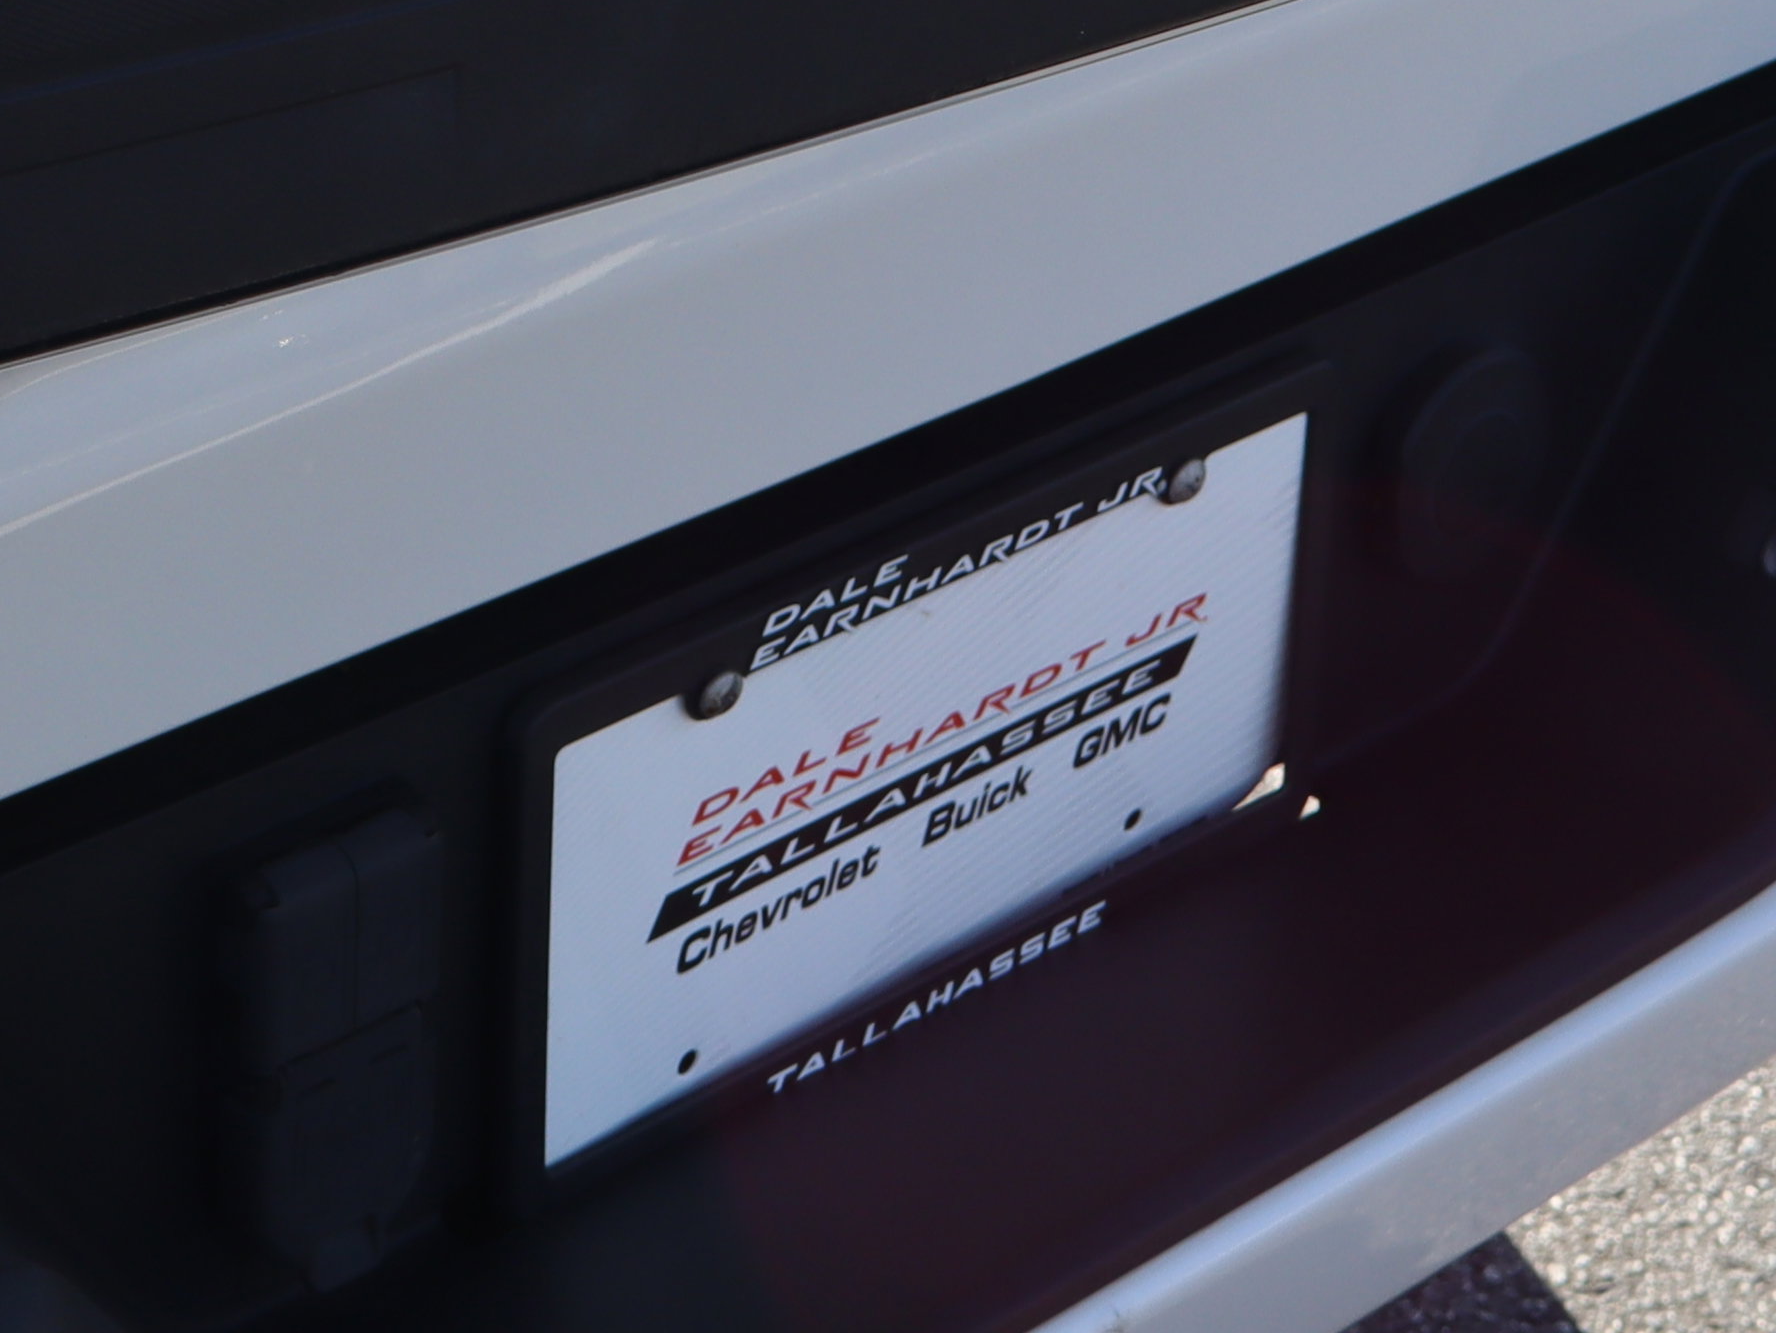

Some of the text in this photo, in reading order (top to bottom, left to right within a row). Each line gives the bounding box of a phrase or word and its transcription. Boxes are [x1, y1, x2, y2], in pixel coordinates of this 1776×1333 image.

[750, 503, 1084, 671] EARNHARDT
[763, 555, 908, 637] DALE
[676, 693, 1172, 974] Chevrolet Buick GMC
[677, 640, 1107, 867] EARNHARDT
[691, 659, 1162, 908] TALLAHASSEE
[692, 717, 880, 826] DALE
[767, 900, 1107, 1094] TALLAHASSEE
